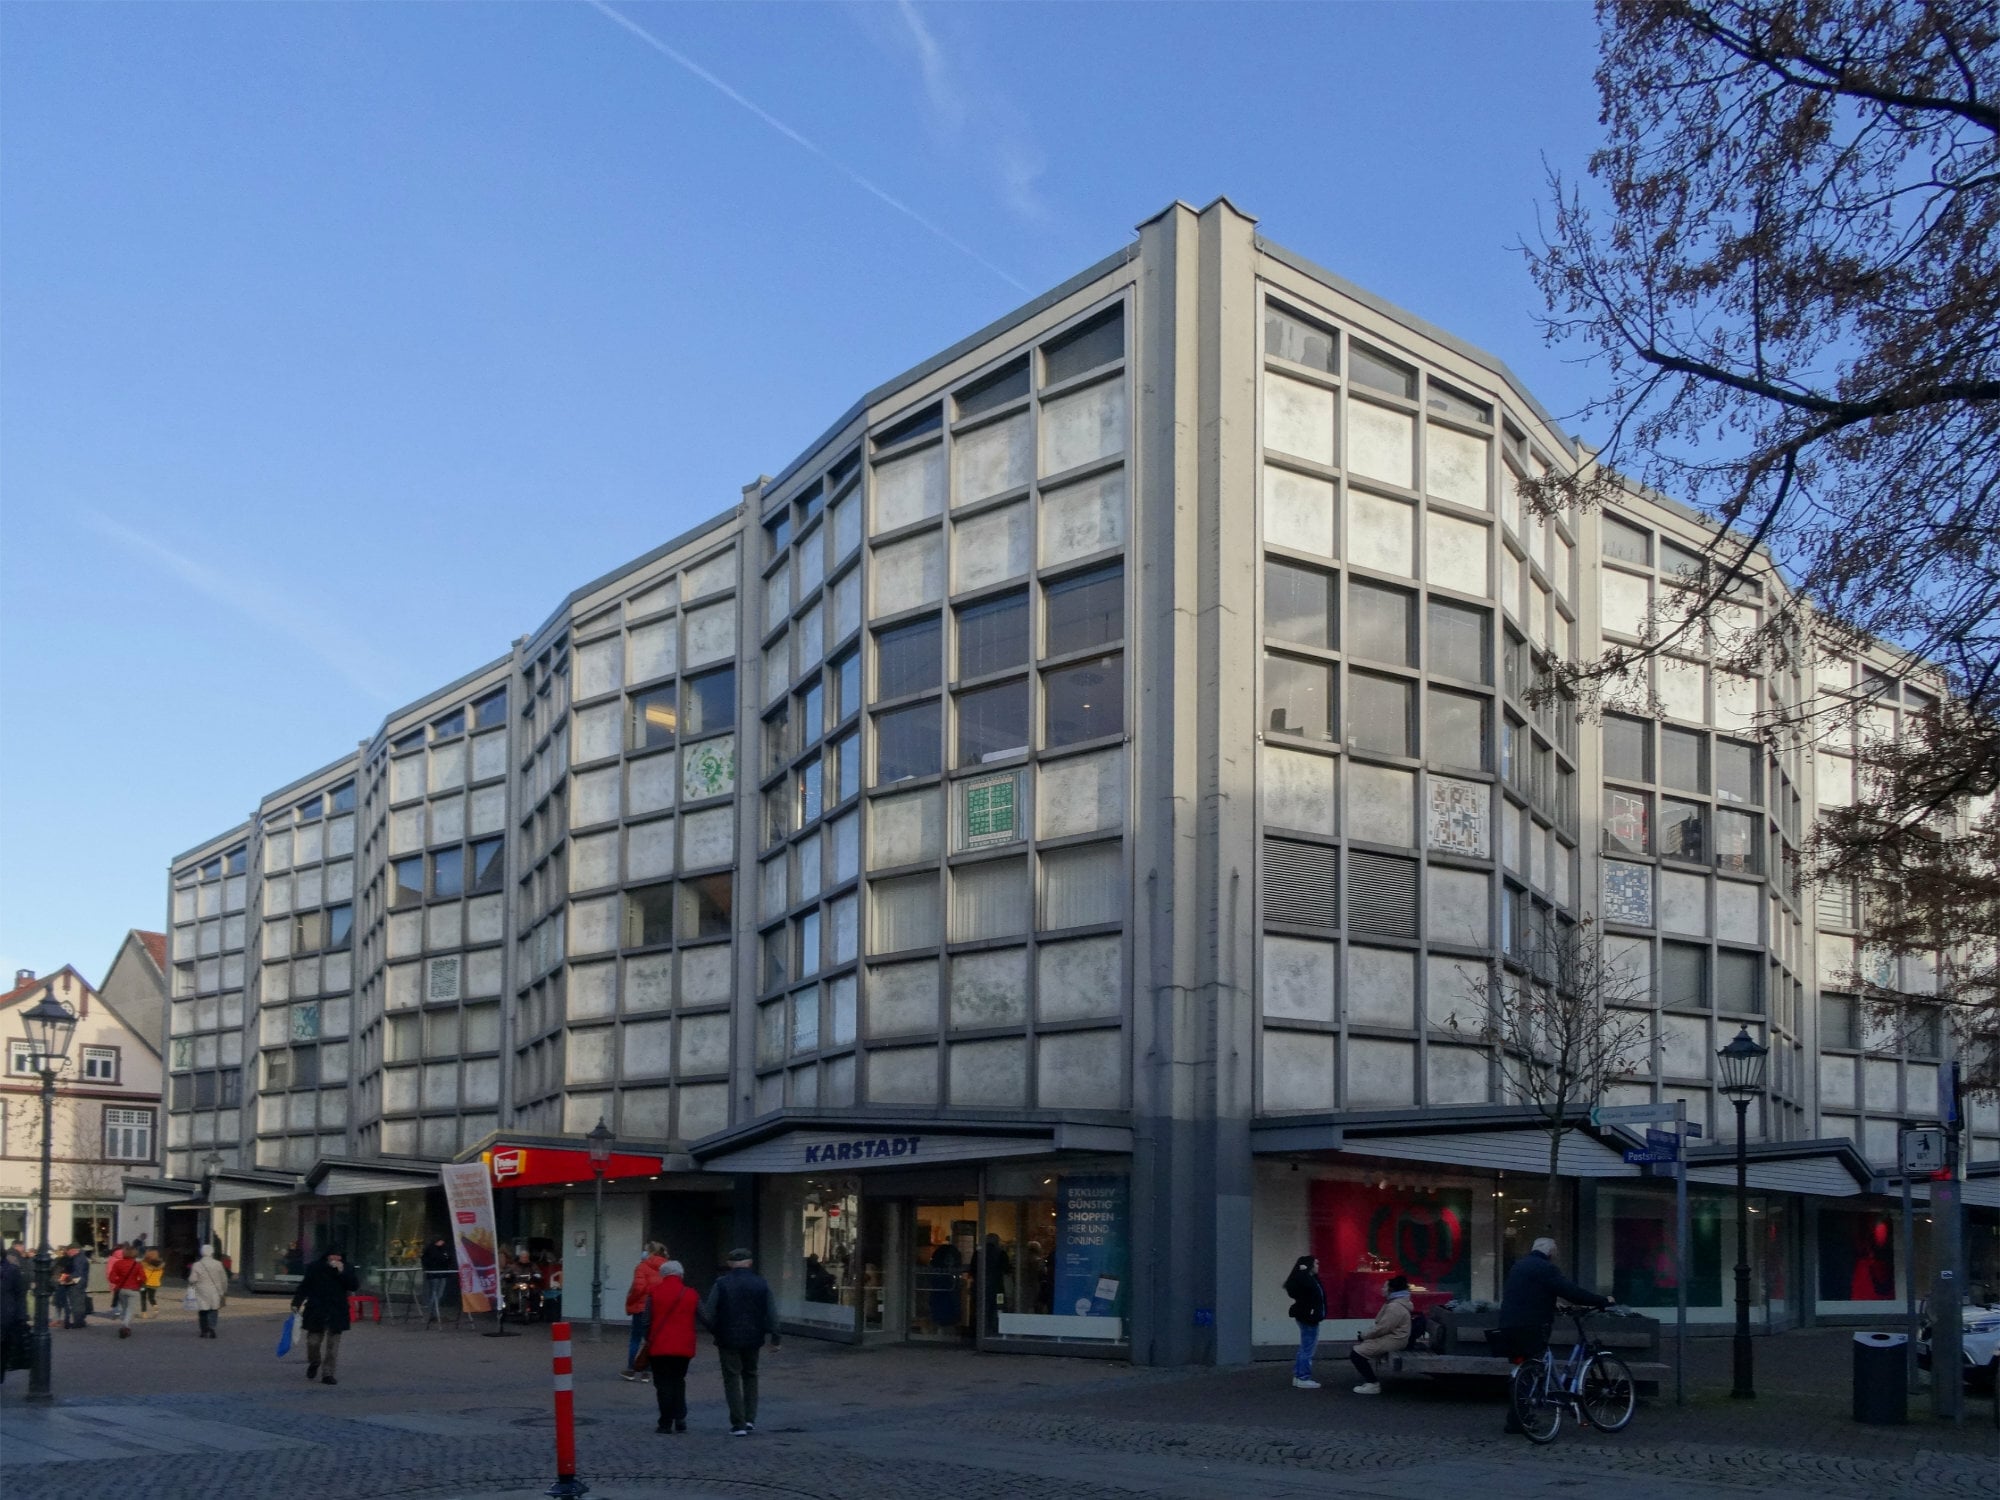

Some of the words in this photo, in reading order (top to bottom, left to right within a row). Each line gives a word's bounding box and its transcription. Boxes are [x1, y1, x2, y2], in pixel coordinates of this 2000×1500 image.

[806, 1137, 920, 1163] KARSTADT
[1068, 1188, 1115, 1198] EXKLUSIV
[1068, 1199, 1113, 1209] GÜNSTIG
[1068, 1212, 1114, 1222] SHOPPEN
[1067, 1224, 1086, 1233] HIER
[1088, 1224, 1109, 1233] UND
